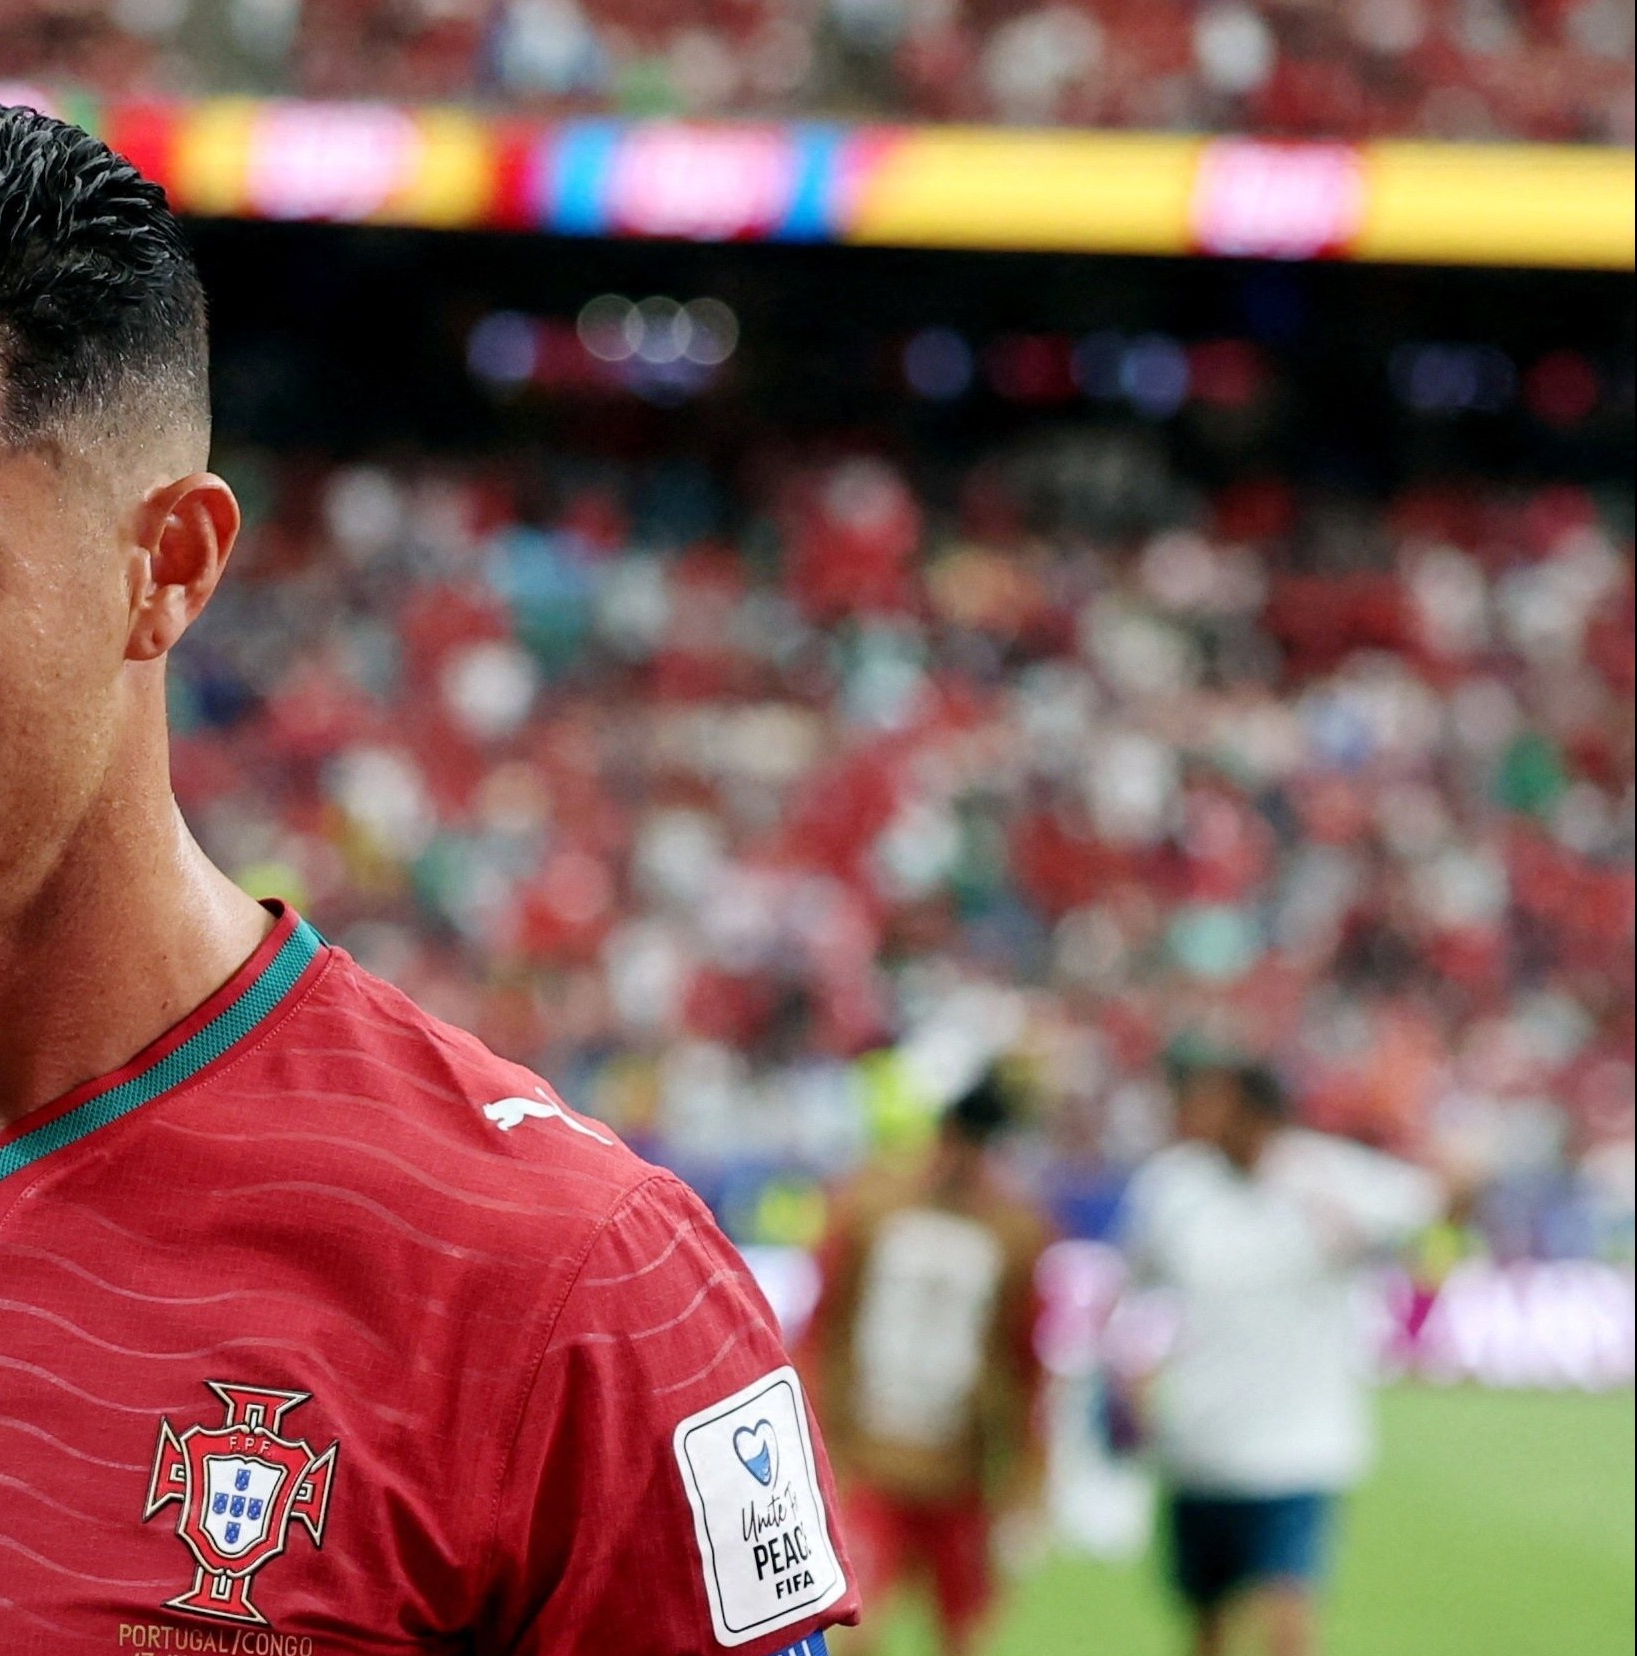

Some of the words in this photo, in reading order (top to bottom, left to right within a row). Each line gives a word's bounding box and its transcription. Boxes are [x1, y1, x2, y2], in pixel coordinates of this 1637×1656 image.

[742, 1494, 787, 1542] Unite
[752, 1521, 812, 1581] PEAC
[775, 1570, 815, 1600] FIFA
